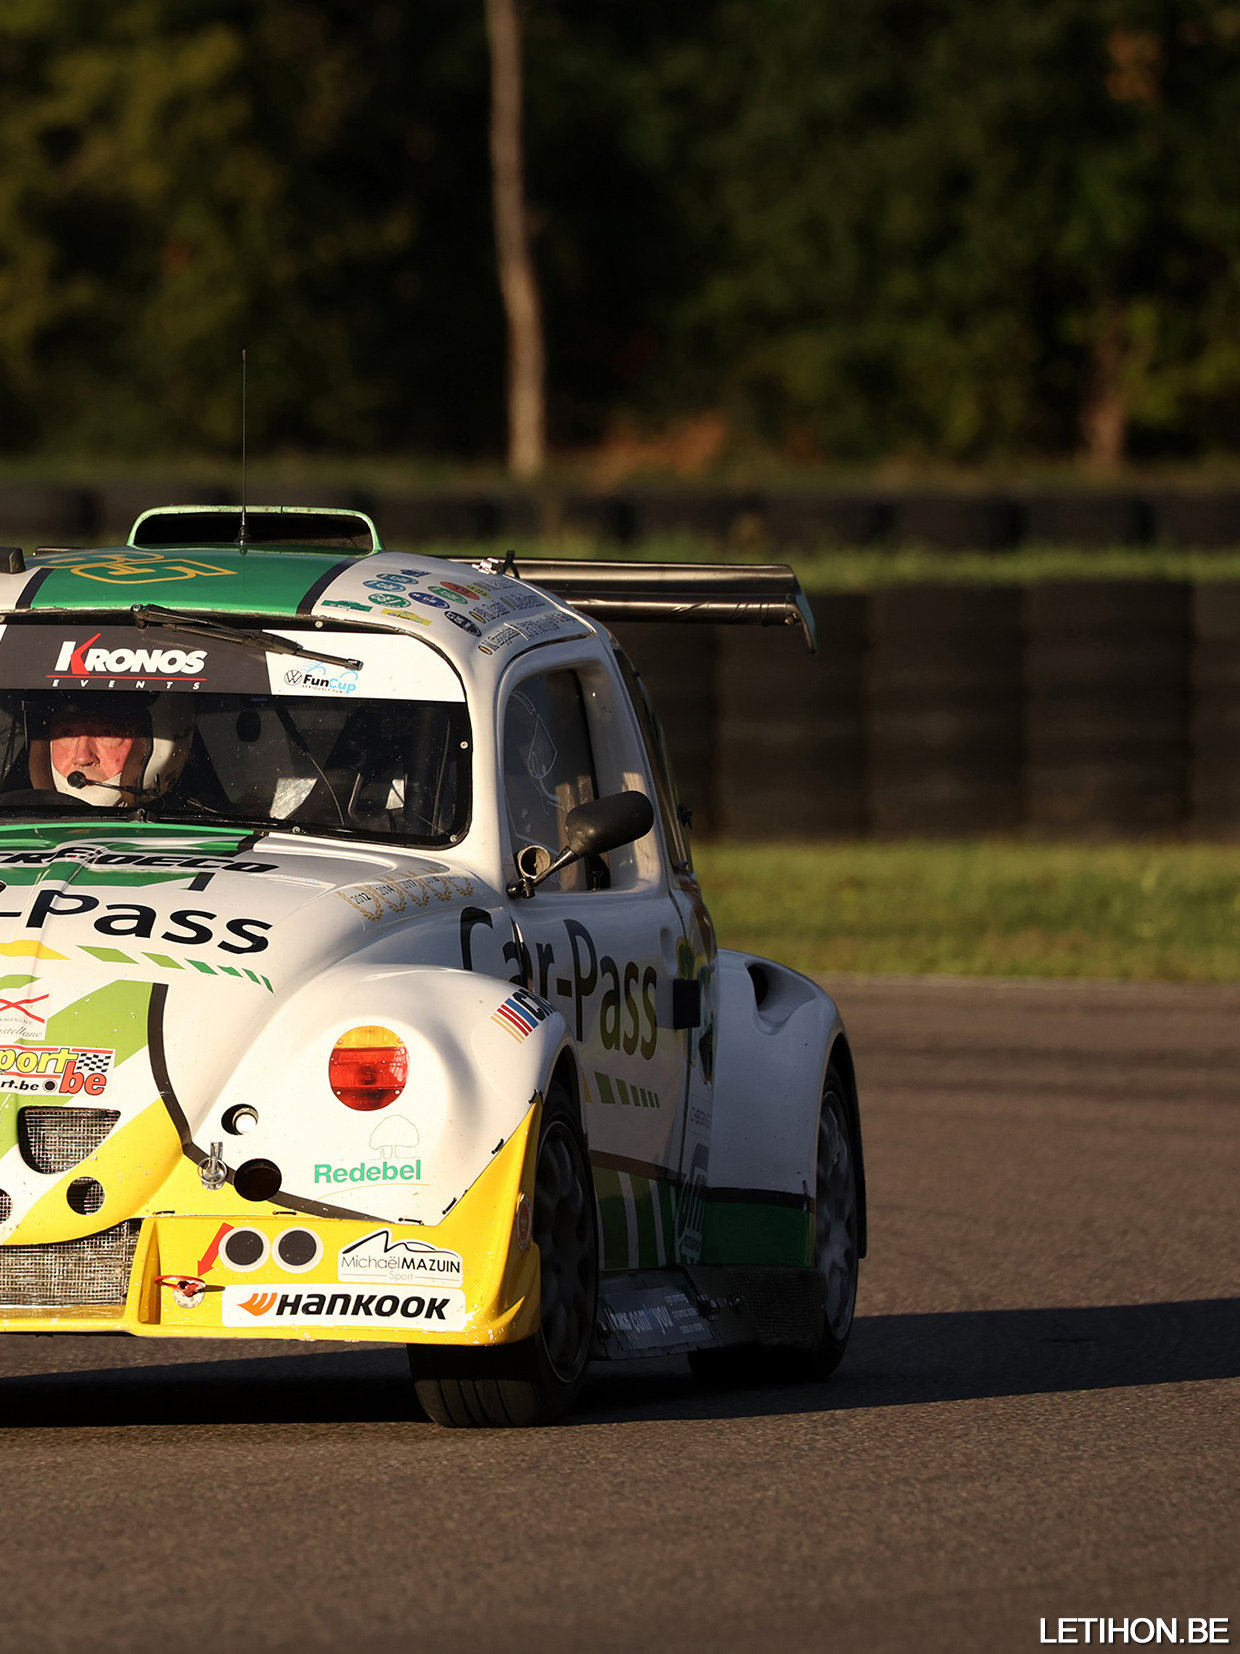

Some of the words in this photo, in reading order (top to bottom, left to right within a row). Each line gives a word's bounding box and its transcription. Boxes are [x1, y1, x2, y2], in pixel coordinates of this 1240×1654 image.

[54, 633, 208, 675] KRONOS
[52, 678, 201, 690] EVENTS
[303, 674, 357, 694] FunCup
[314, 1159, 422, 1184] Redebel
[388, 1270, 415, 1282] Sport
